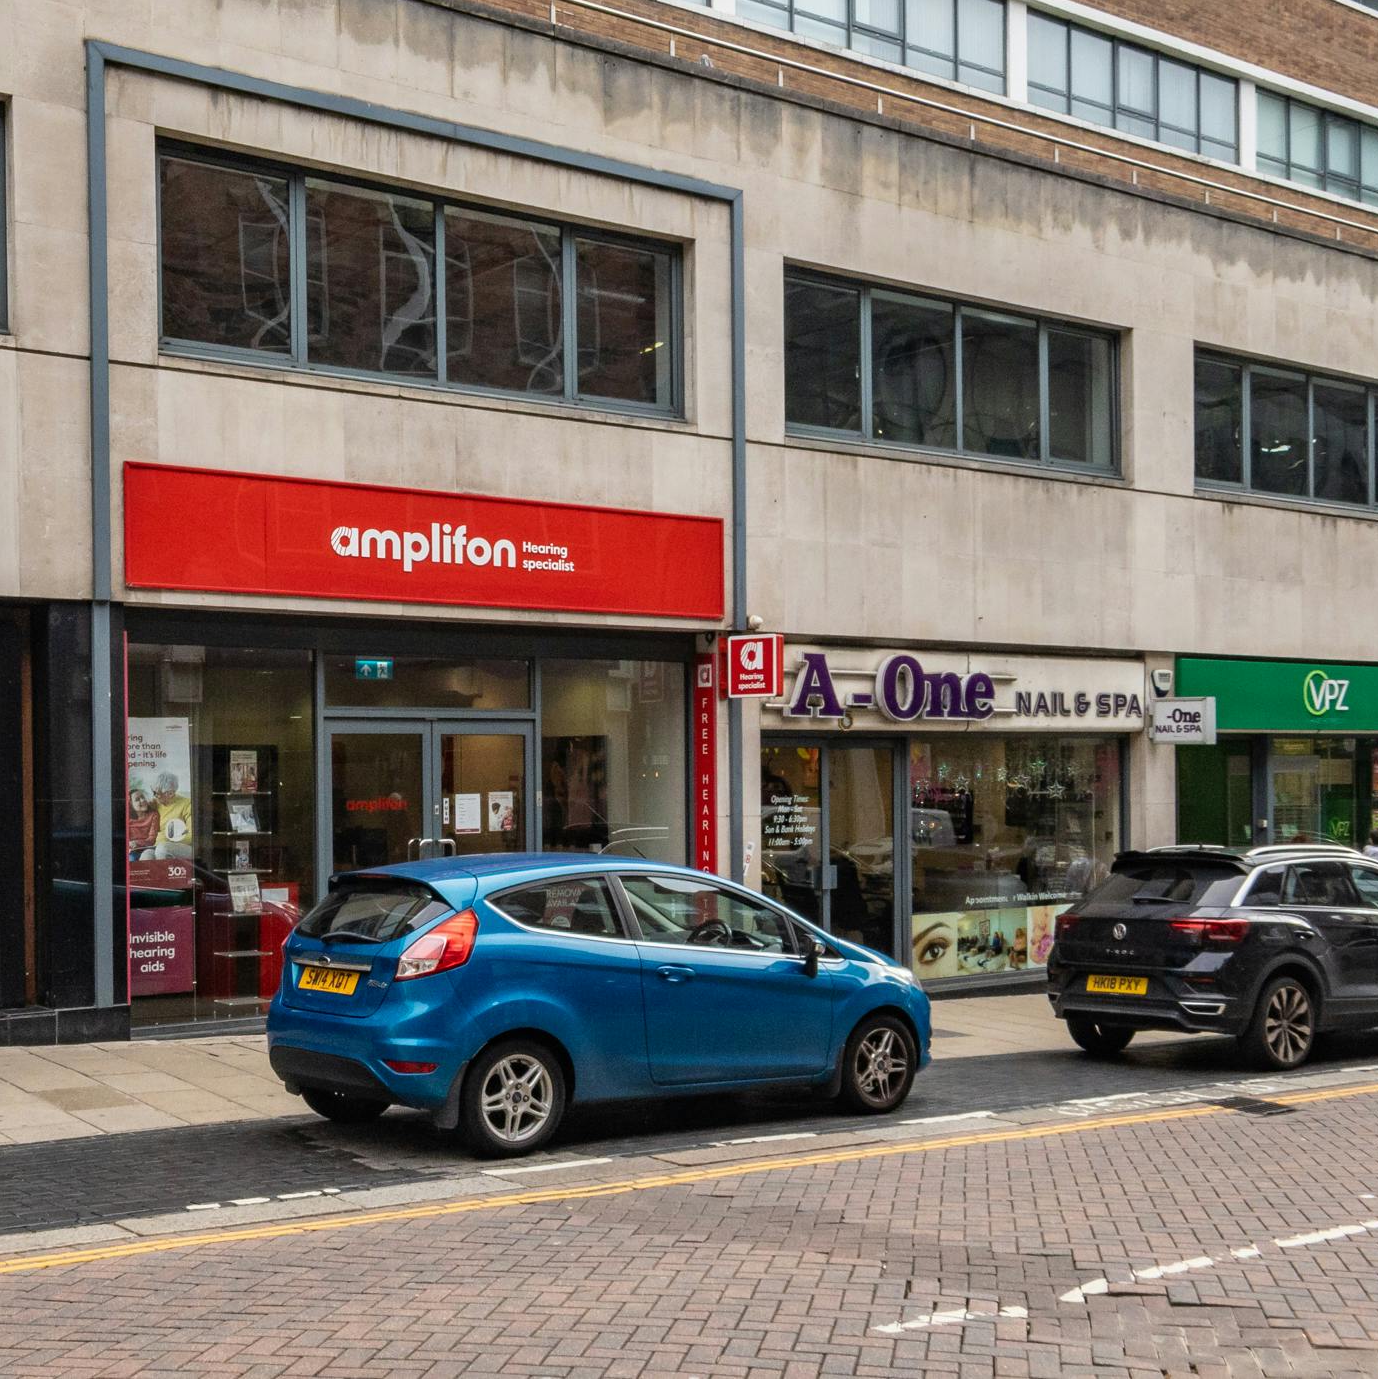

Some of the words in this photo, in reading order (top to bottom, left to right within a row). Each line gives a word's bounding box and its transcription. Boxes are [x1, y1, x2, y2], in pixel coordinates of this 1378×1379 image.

[330, 522, 517, 572] amplifon
[523, 541, 568, 557] Hearing
[523, 559, 574, 572] specialist
[739, 673, 764, 681] Hearing
[738, 682, 766, 691] specialist
[787, 651, 996, 722] A-One
[1016, 691, 1071, 716] NAIL
[1075, 692, 1090, 716] &
[1096, 693, 1143, 718] SPA
[1309, 679, 1350, 711] VPZ
[1155, 725, 1175, 733] NAIL
[1176, 725, 1182, 733] &
[1183, 725, 1202, 733] SPA
[142, 742, 161, 750] than
[771, 794, 792, 805] Opening
[1017, 892, 1039, 901] Walkin
[1039, 891, 1067, 900] Welcome
[129, 931, 175, 944] Invisible
[129, 946, 175, 959] hearing
[140, 961, 165, 972] aids
[1093, 977, 1116, 990] HK18
[1118, 977, 1141, 991] PXY
